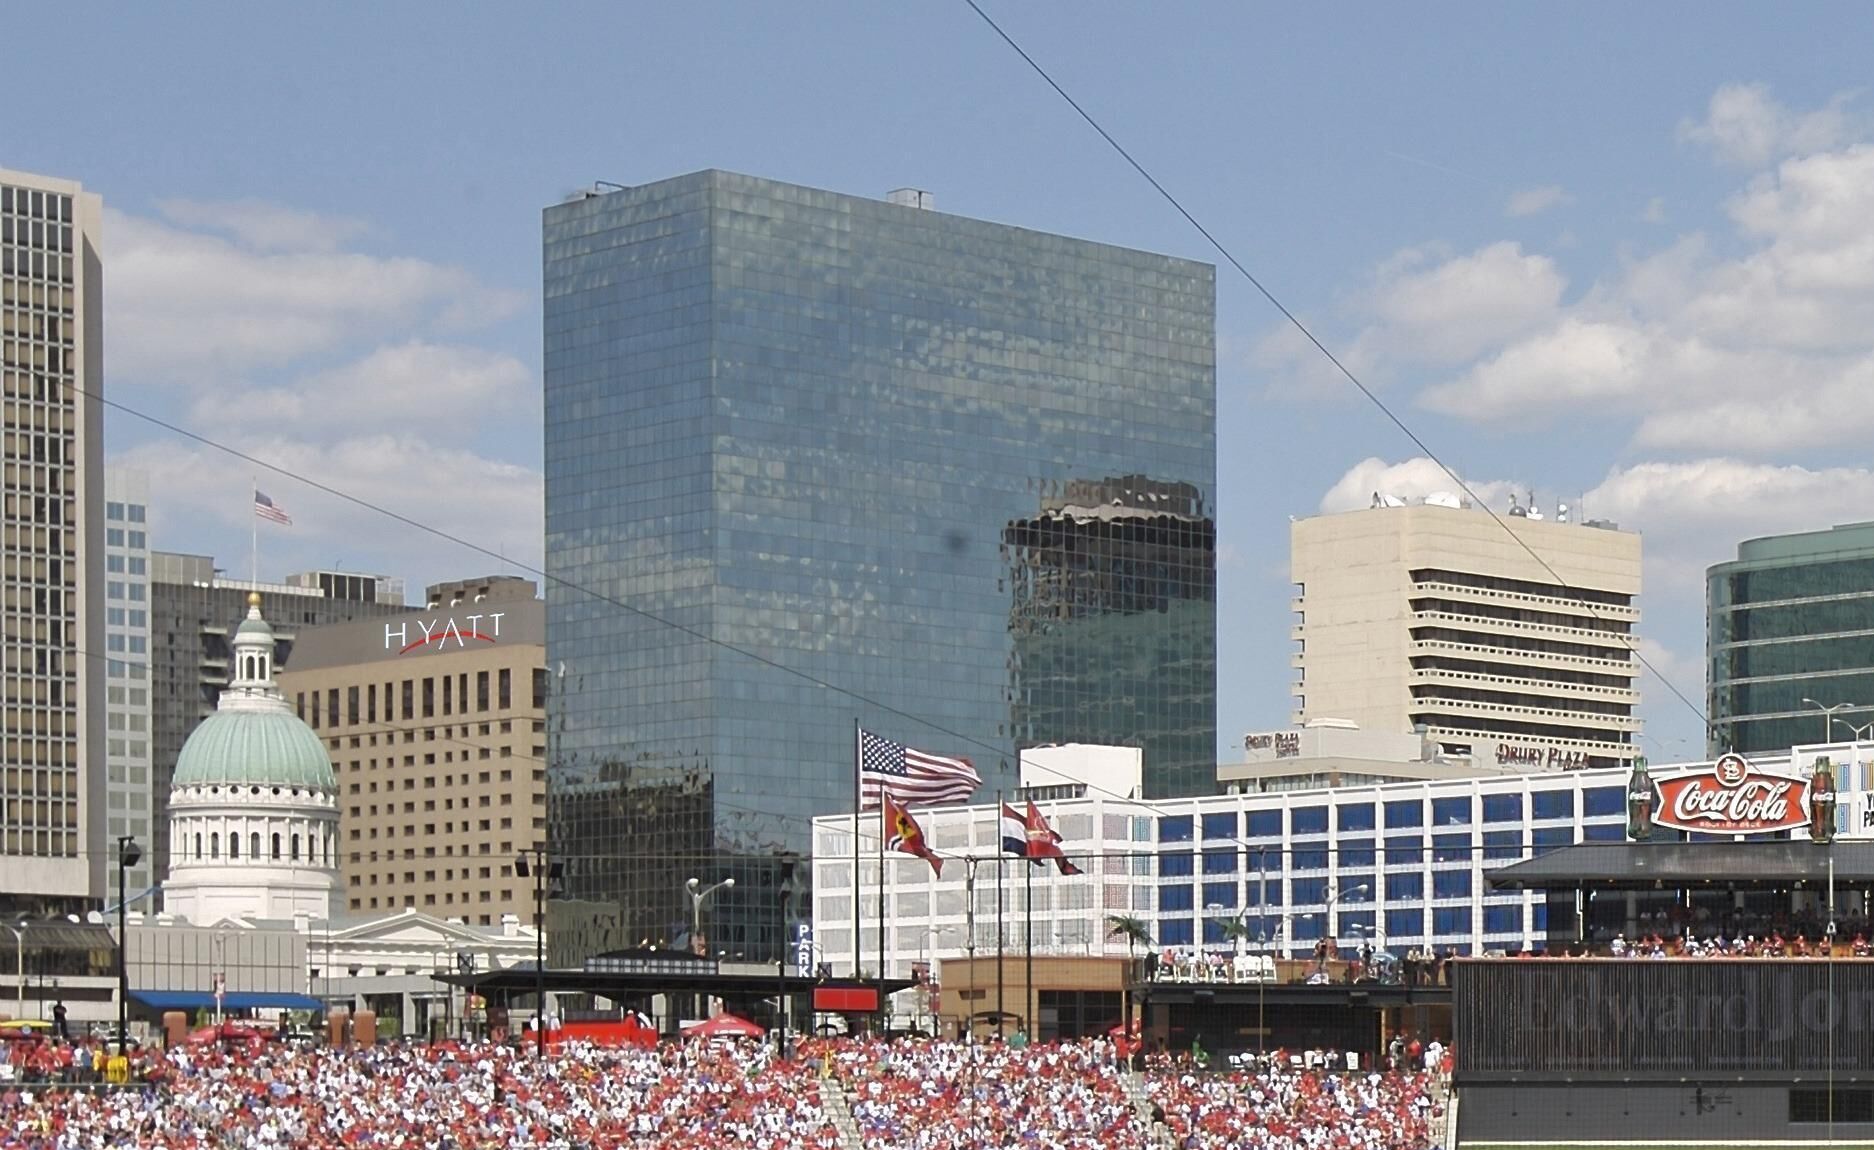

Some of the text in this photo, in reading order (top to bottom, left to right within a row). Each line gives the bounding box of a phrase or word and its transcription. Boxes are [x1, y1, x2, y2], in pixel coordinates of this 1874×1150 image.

[385, 613, 504, 650] HYATT
[1495, 743, 1545, 766] DRURY
[1548, 747, 1590, 767] PLAZA
[1674, 781, 1792, 821] Coca-Cola
[799, 924, 810, 978] PARK
[1520, 968, 1760, 1033] Edward
